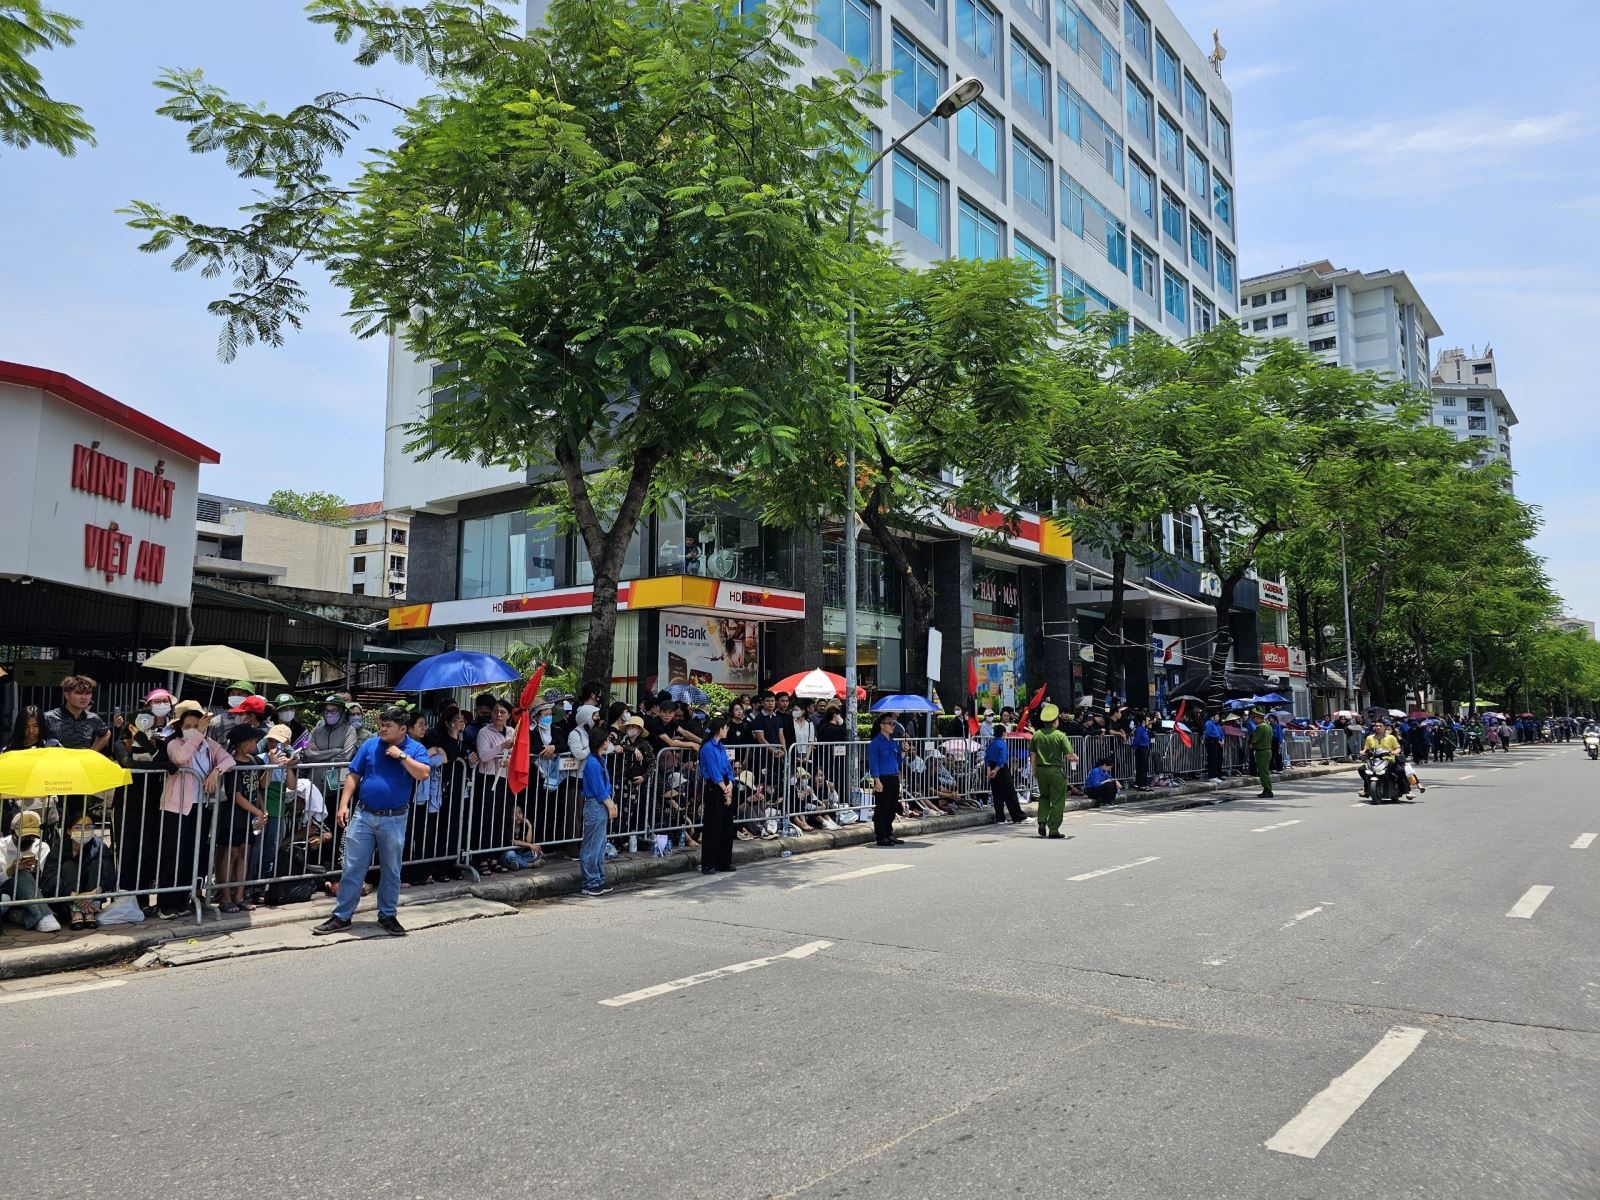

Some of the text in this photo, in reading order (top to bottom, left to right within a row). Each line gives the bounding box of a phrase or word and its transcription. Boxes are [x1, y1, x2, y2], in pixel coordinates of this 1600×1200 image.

[72, 441, 176, 519] KÍNH MẮT
[85, 521, 166, 584] VIỆT AN
[730, 591, 763, 605] HDBank
[493, 601, 521, 613] HDBank
[666, 624, 707, 640] HDBank
